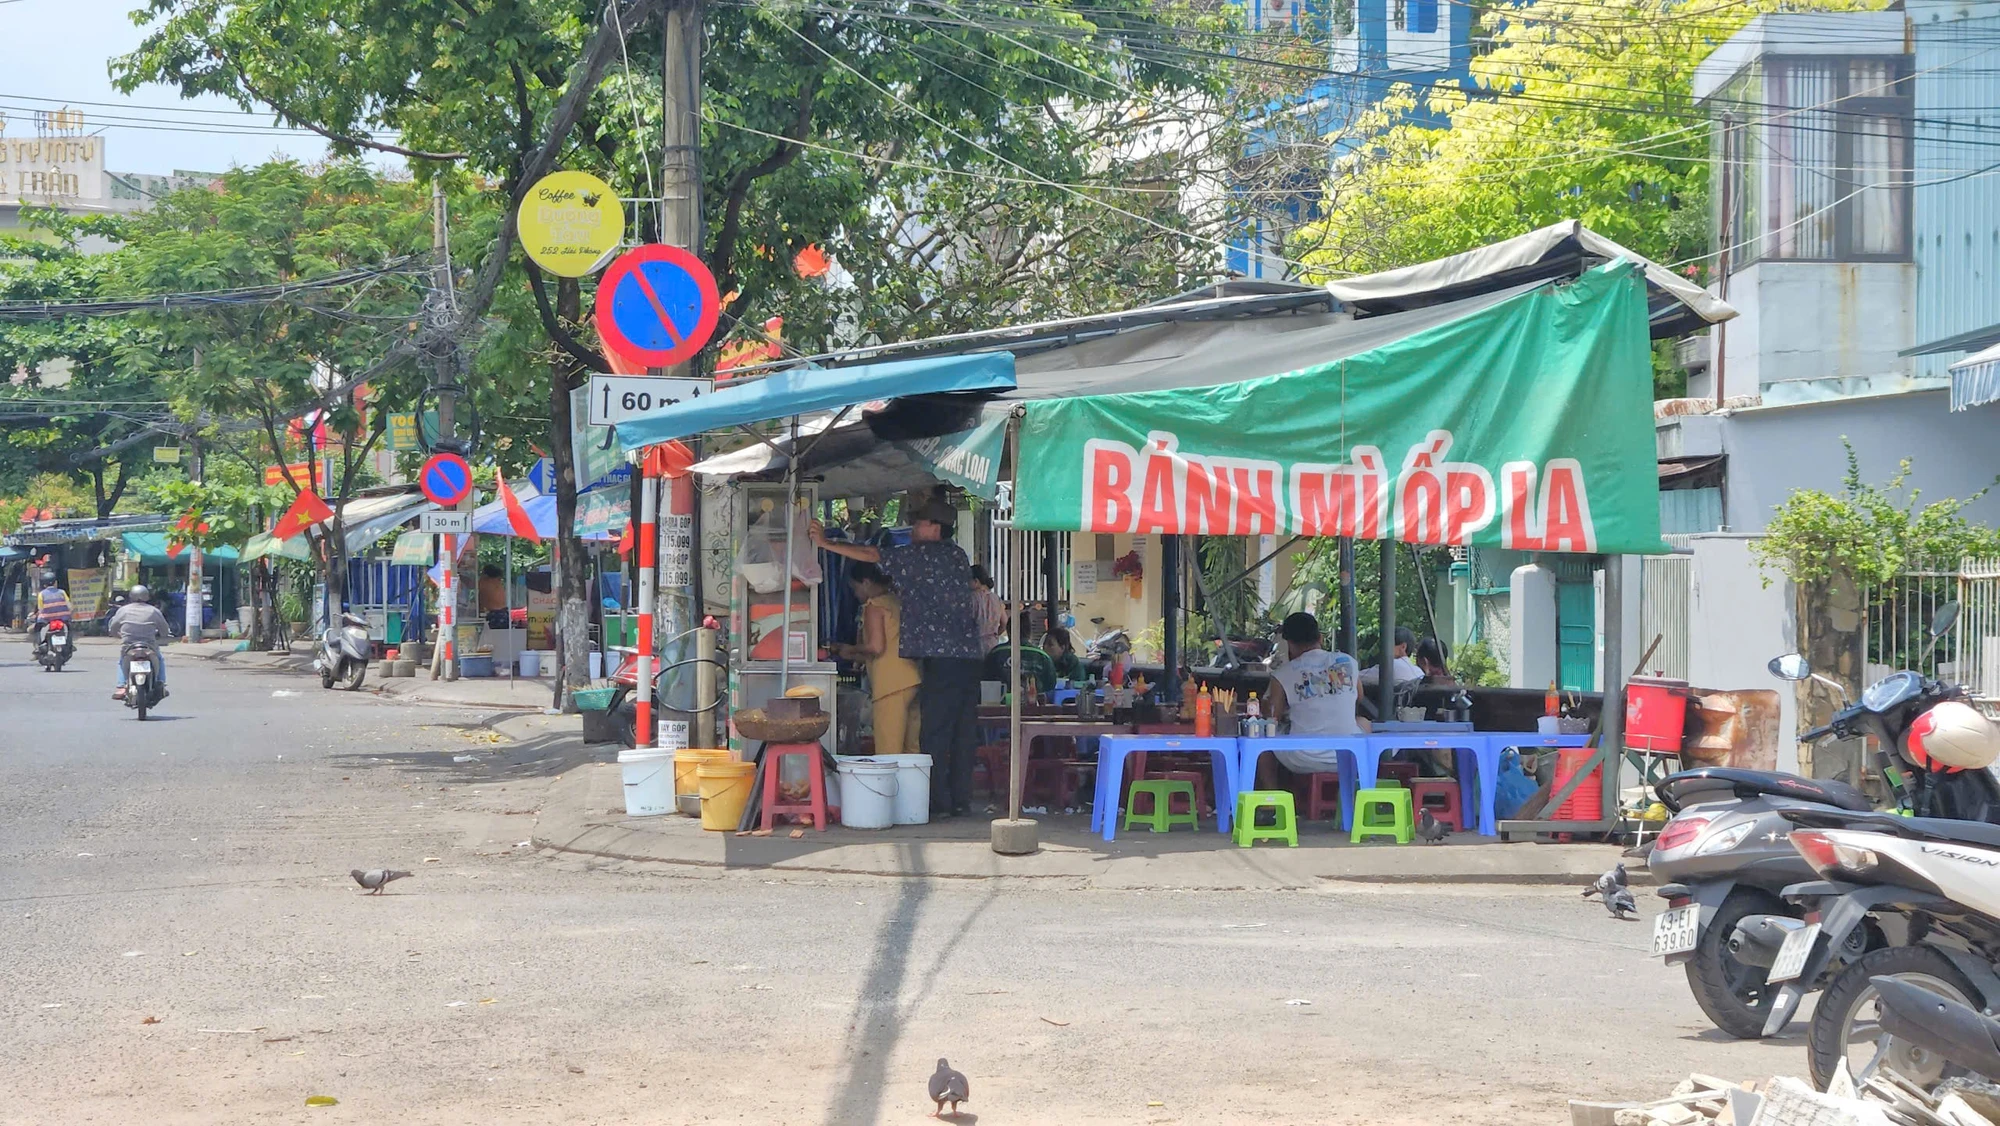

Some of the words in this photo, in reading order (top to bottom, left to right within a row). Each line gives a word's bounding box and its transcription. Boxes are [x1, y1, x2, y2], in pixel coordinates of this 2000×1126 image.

[538, 188, 575, 203] Coffee
[540, 247, 559, 255] 252
[621, 392, 652, 411] 60
[964, 451, 991, 489] LOẠI
[1297, 453, 1381, 540] MÌ
[1400, 438, 1488, 546] ỐP
[1510, 466, 1590, 552] LA
[1921, 846, 2000, 867] VISION
[1660, 910, 1691, 932] 43-E1
[1654, 929, 1694, 952] 639.60
